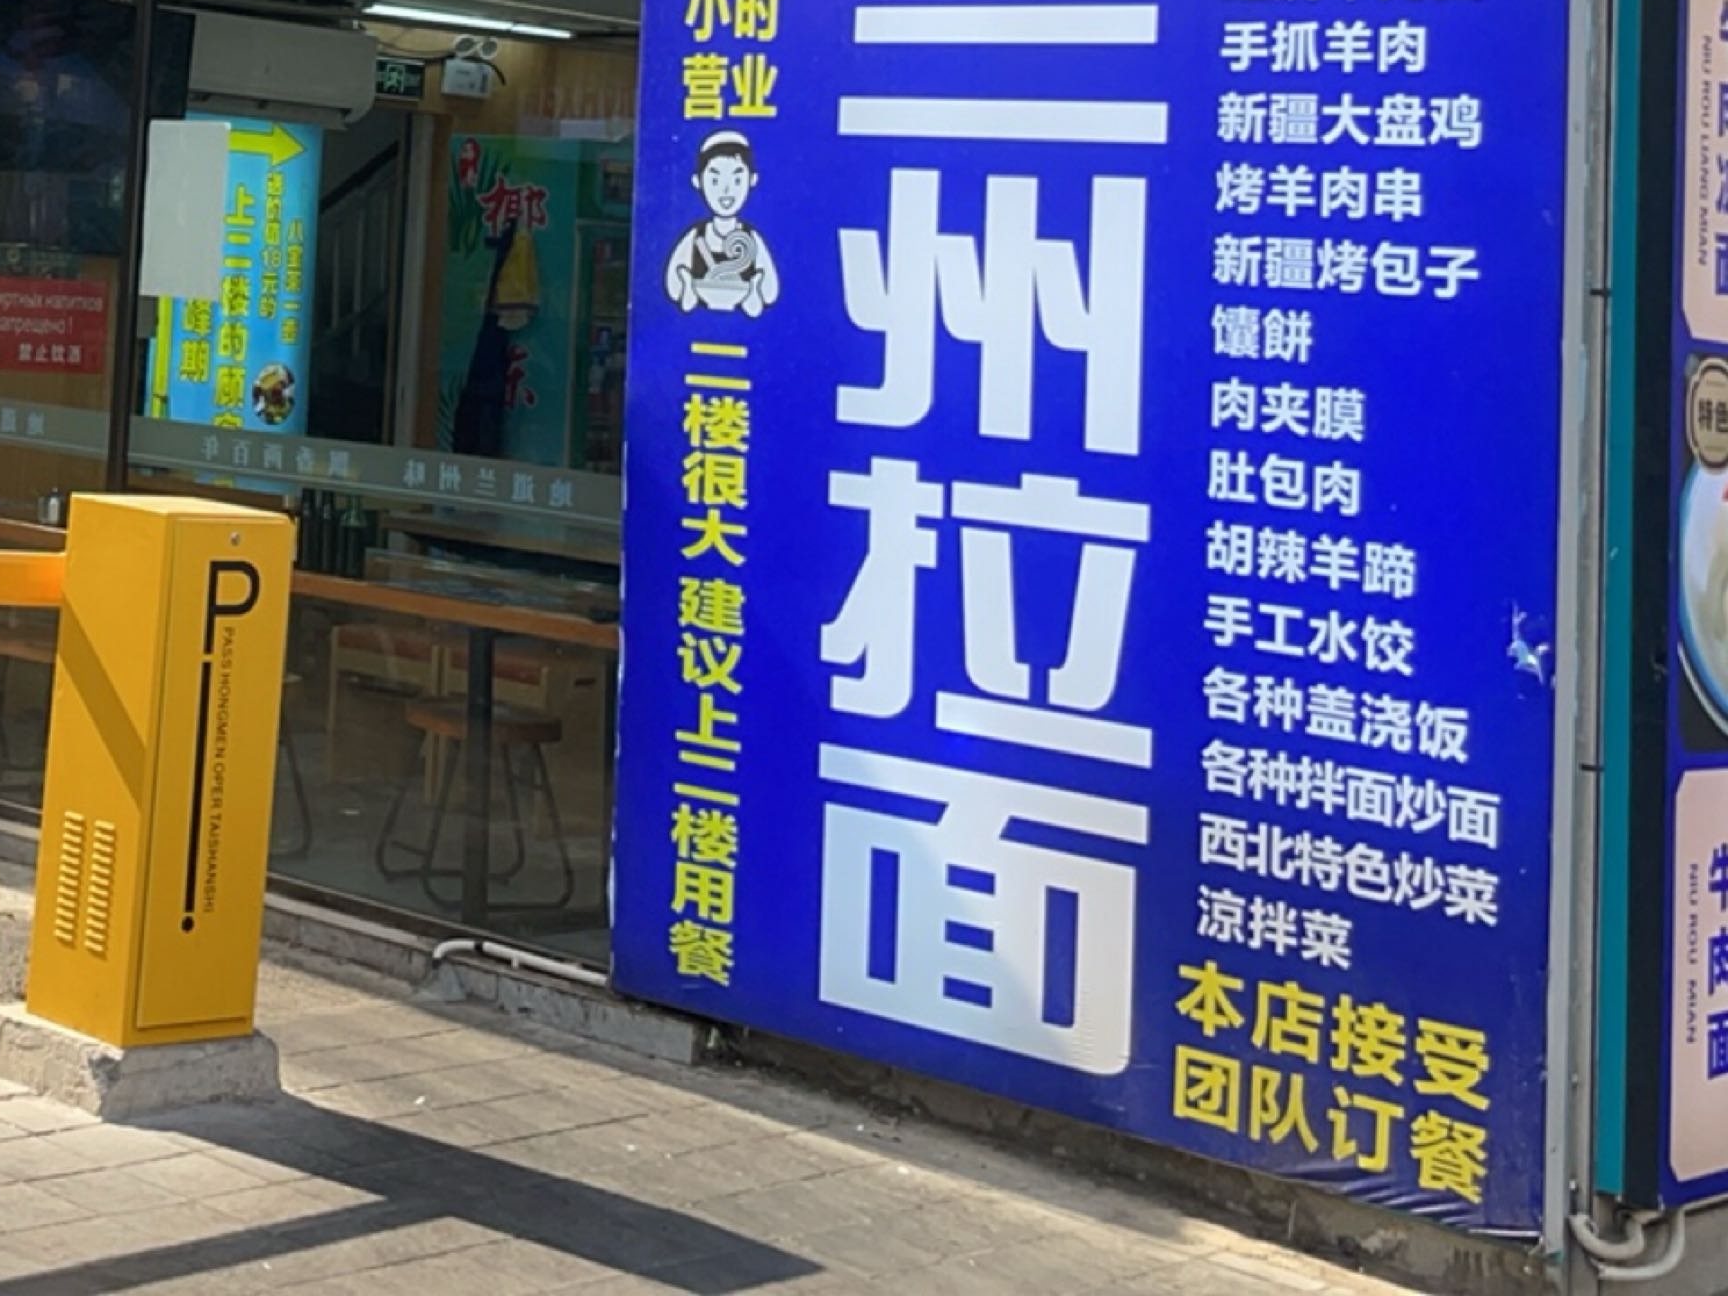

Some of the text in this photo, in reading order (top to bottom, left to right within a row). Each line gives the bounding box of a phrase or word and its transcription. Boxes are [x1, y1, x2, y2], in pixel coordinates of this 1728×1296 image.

[683, 54, 778, 119] 营业
[1220, 20, 1427, 74] 手抓羊肉
[1216, 92, 1483, 149] 新疆大盘鸡
[1214, 162, 1424, 222] 烤羊肉串
[1213, 233, 1479, 300] 新疆烤包子
[1210, 376, 1366, 442] 肉夹膜
[1208, 450, 1361, 518] 肚包肉
[1205, 521, 1417, 600] 胡辣羊蹄
[668, 340, 751, 987] 二楼很大 建议上二楼用餐
[1203, 593, 1415, 677] 手工水饺
[1202, 666, 1470, 764] 各种盖浇饭
[1200, 739, 1501, 850] 各种拌面炒面
[1197, 811, 1499, 927] 西北特色炒菜
[1175, 960, 1492, 1111] 本店接受
[1173, 1044, 1487, 1204] 团队订餐
